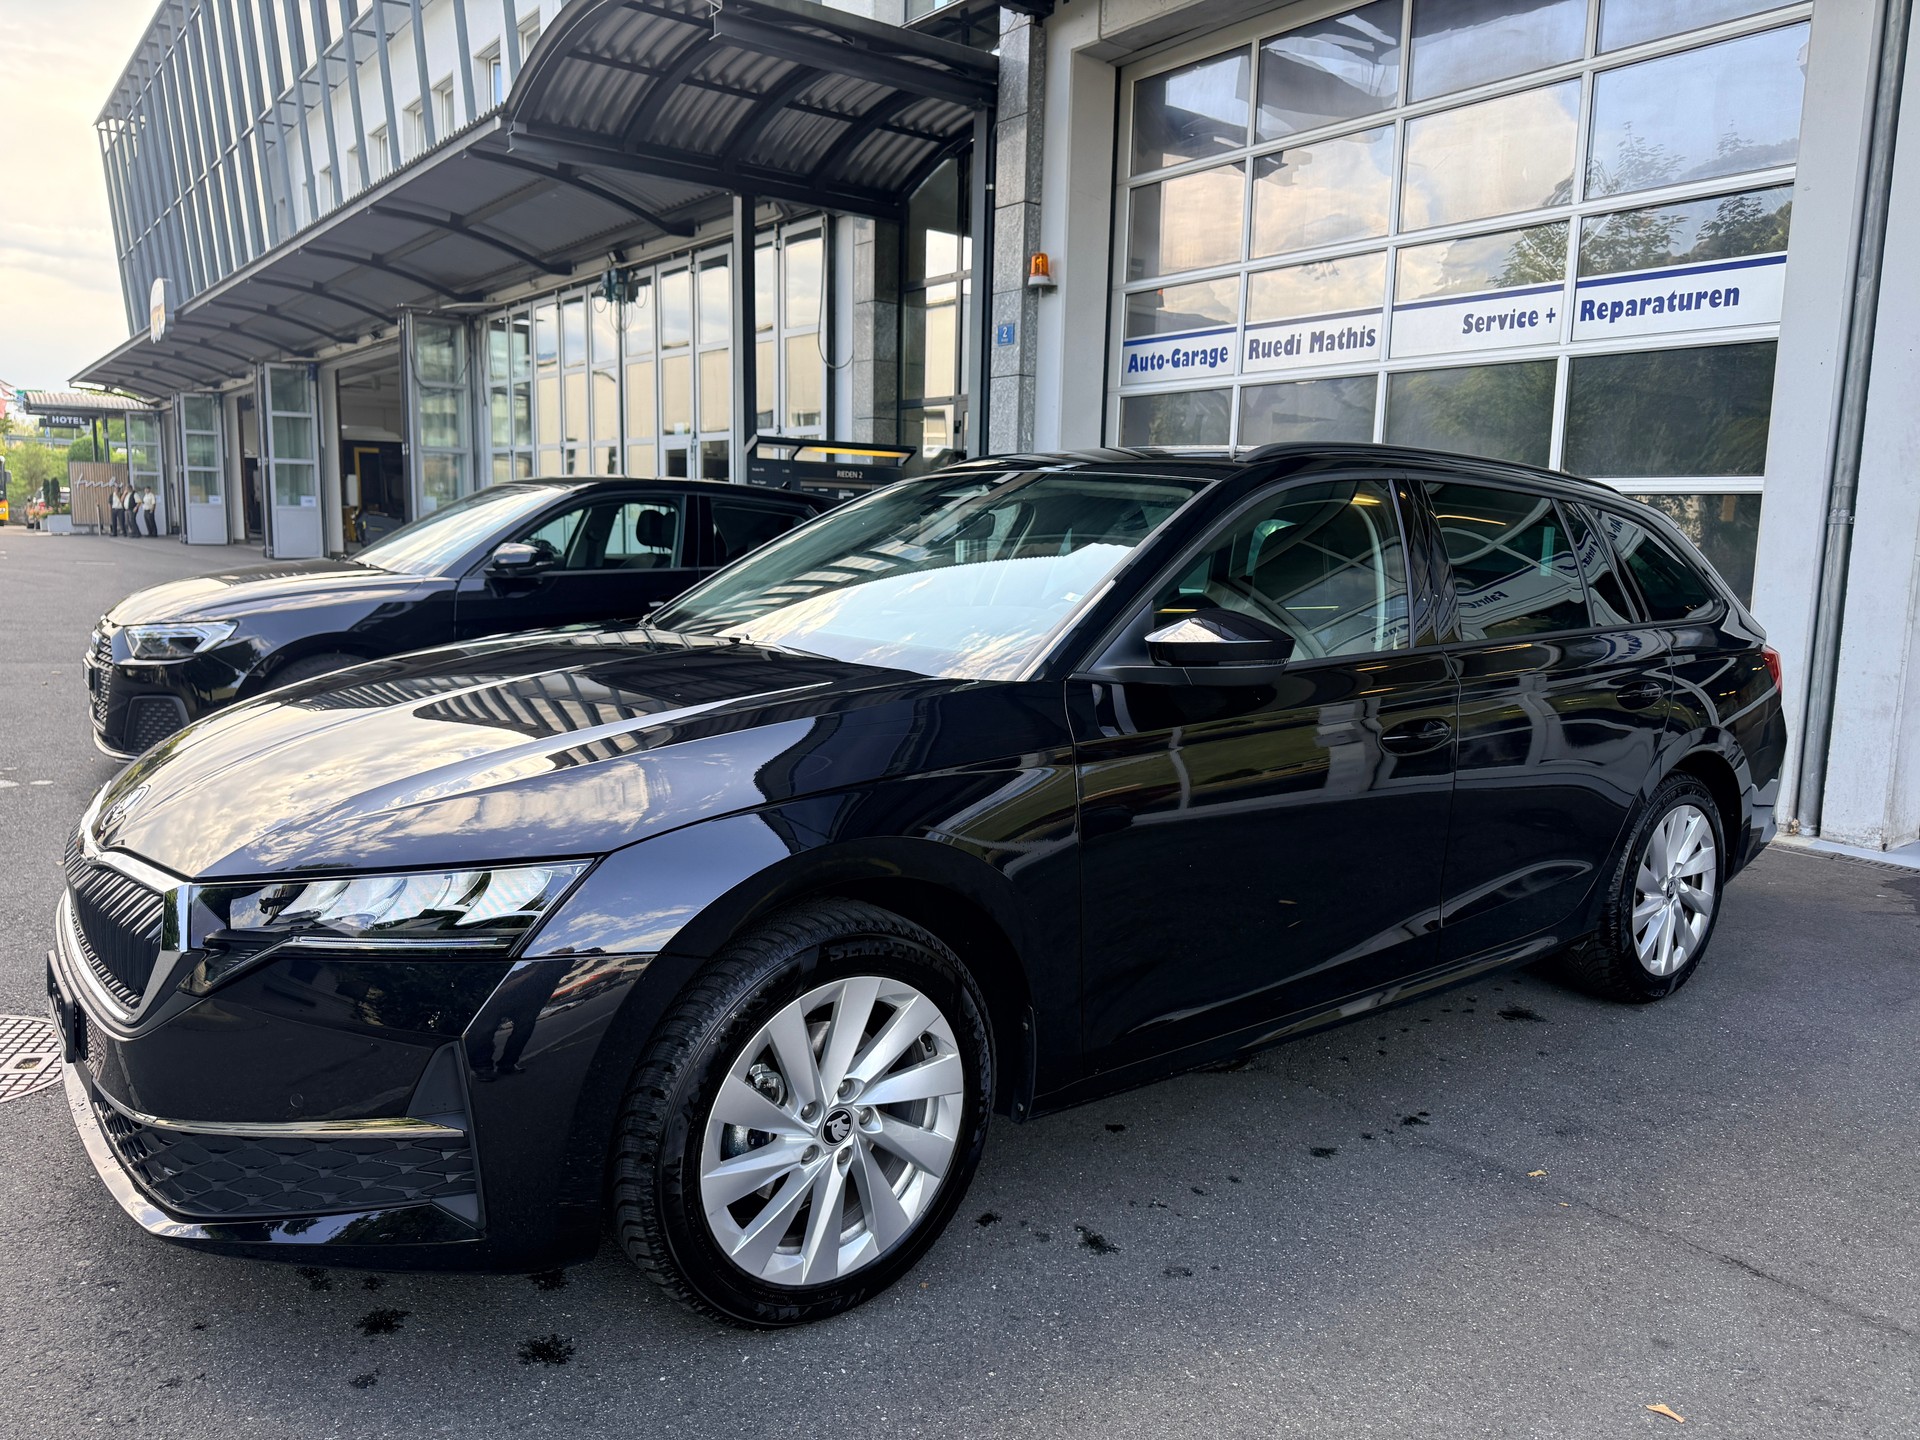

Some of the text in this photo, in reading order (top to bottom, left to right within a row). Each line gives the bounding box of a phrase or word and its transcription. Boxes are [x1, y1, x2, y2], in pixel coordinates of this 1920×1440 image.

[1462, 286, 1740, 334] Service + Reparaturen
[1002, 326, 1008, 338] 2
[1127, 325, 1376, 373] Auto-Garage Ruedi Mathis
[52, 415, 85, 424] HOTEL
[858, 470, 864, 479] 2
